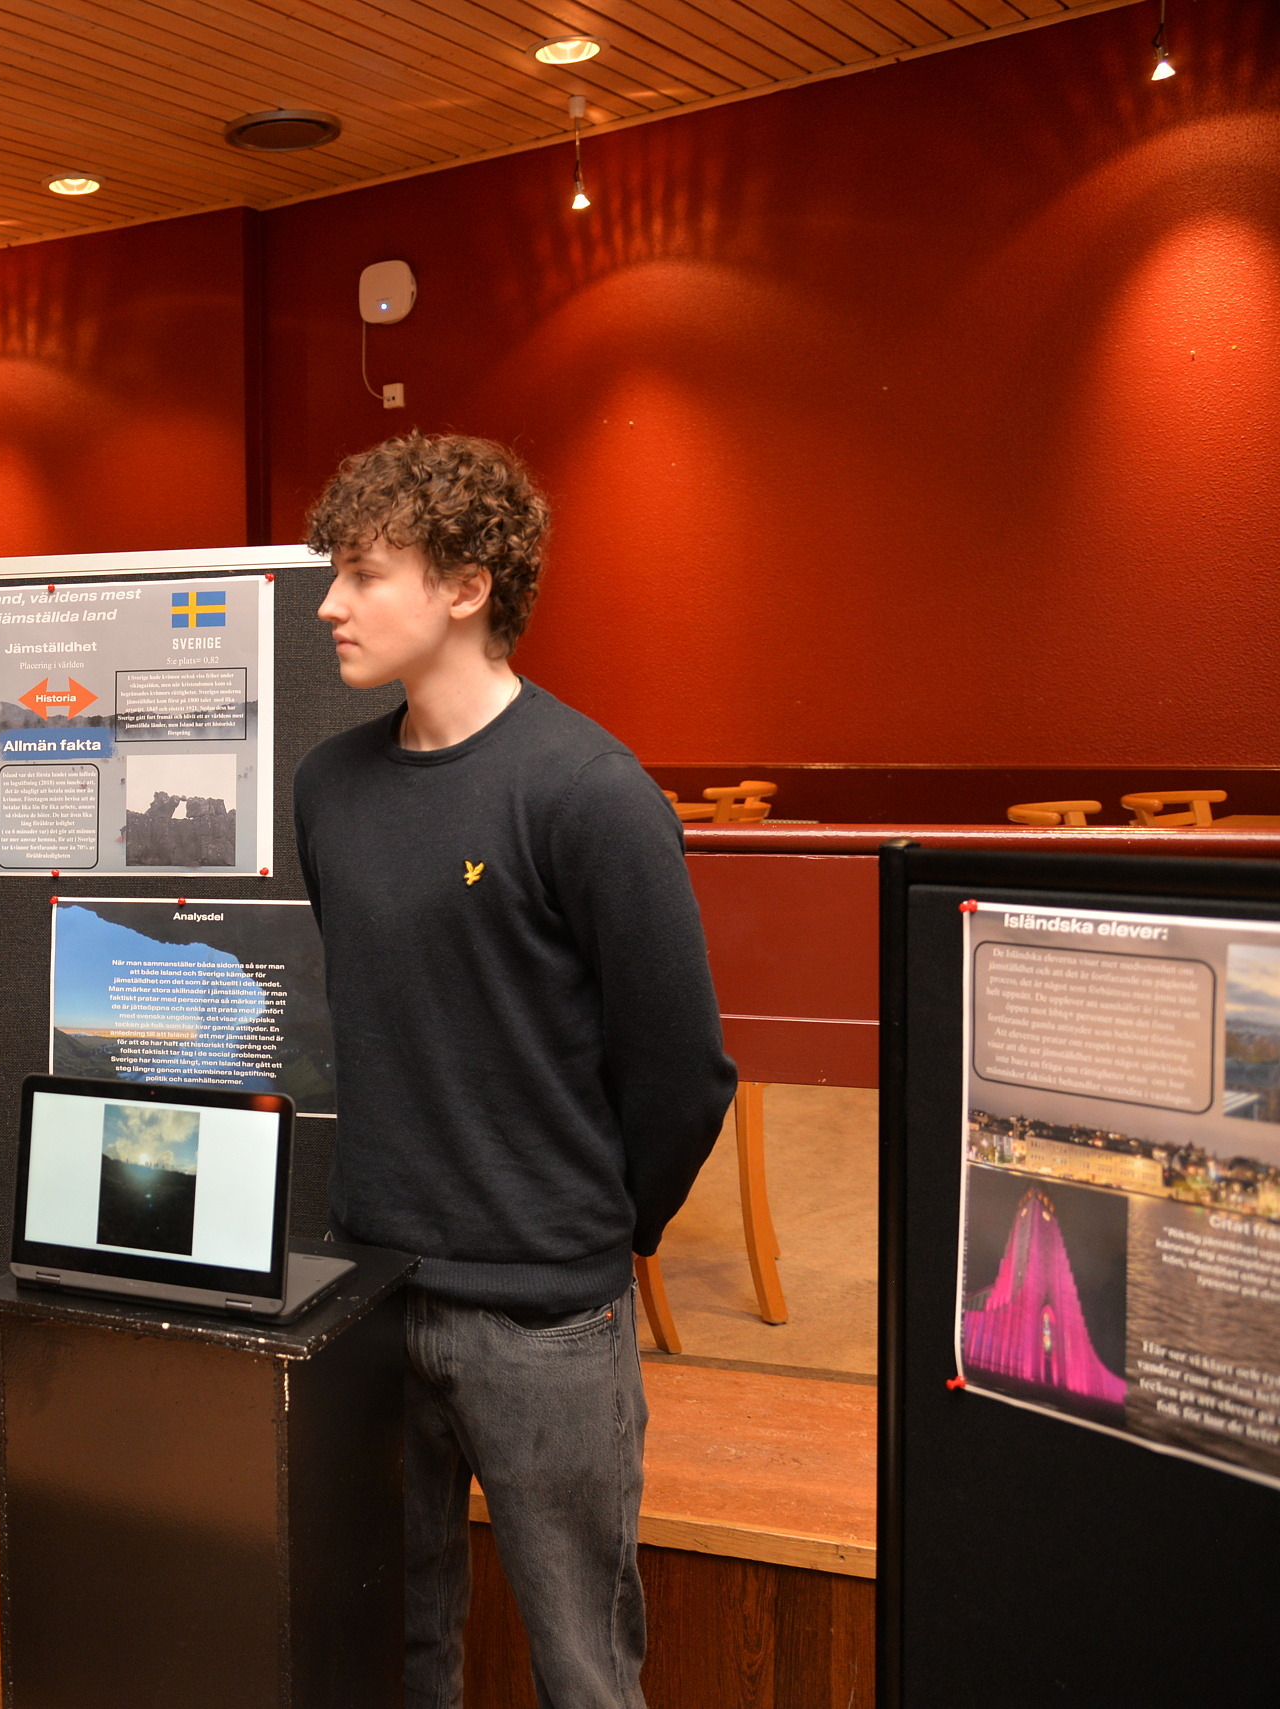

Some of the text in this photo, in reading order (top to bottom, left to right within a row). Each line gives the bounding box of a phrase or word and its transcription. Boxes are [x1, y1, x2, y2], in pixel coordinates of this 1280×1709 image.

[30, 591, 98, 604] världens
[100, 589, 142, 601] mest
[83, 609, 117, 622] land
[5, 641, 97, 654] Jämställdhet
[173, 637, 222, 650] SVERIGE
[203, 656, 219, 664] 0,82
[20, 662, 52, 671] Placering
[58, 661, 85, 669] världen
[35, 694, 77, 703] Historia
[3, 739, 101, 752] Allmän fakta
[173, 912, 224, 923] Analysdel
[1004, 913, 1169, 941] Isländska elever:
[143, 959, 196, 967] sammanställer
[197, 960, 216, 968] båda
[245, 961, 254, 969] så
[141, 968, 159, 976] både
[160, 968, 182, 976] Island
[197, 969, 225, 978] Sverige
[226, 970, 254, 978] kämpar
[255, 970, 266, 978] för
[114, 977, 158, 986] jämställdhet
[202, 978, 210, 986] är
[211, 978, 238, 986] aktuellt
[256, 979, 281, 987] landet.
[108, 985, 125, 993] Man
[125, 985, 151, 993] märker
[171, 986, 207, 994] skillnader
[211, 987, 257, 996] jämställdhet
[257, 988, 270, 996] när
[137, 995, 160, 1003] pratar
[221, 996, 230, 1004] så
[230, 996, 257, 1004] märker
[171, 1004, 185, 1012] och
[218, 1006, 238, 1014] prata
[239, 1006, 255, 1014] med
[256, 1006, 284, 1015] jämfört
[249, 1014, 275, 1023] typiska
[226, 1032, 258, 1041] jämställt
[259, 1033, 275, 1041] land
[117, 1038, 128, 1046] för
[150, 1039, 163, 1047] har
[191, 1040, 225, 1048] historiskt
[226, 1041, 262, 1050] försprång
[262, 1042, 276, 1050] och
[120, 1047, 141, 1055] folket
[142, 1047, 169, 1056] faktiskt
[181, 1049, 193, 1057] tag
[198, 1049, 207, 1057] de
[208, 1050, 230, 1058] social
[231, 1050, 273, 1060] problemen.
[111, 1055, 138, 1064] Sverige
[139, 1056, 151, 1064] har
[152, 1056, 179, 1065] kommit
[180, 1057, 201, 1066] långt,
[242, 1059, 254, 1067] har
[255, 1060, 271, 1068] gått
[115, 1065, 132, 1073] steg
[132, 1065, 156, 1074] längre
[194, 1067, 233, 1076] kombinera
[233, 1069, 277, 1078] lagstiftning,
[146, 1074, 243, 1085] politik och samhällsnormer.
